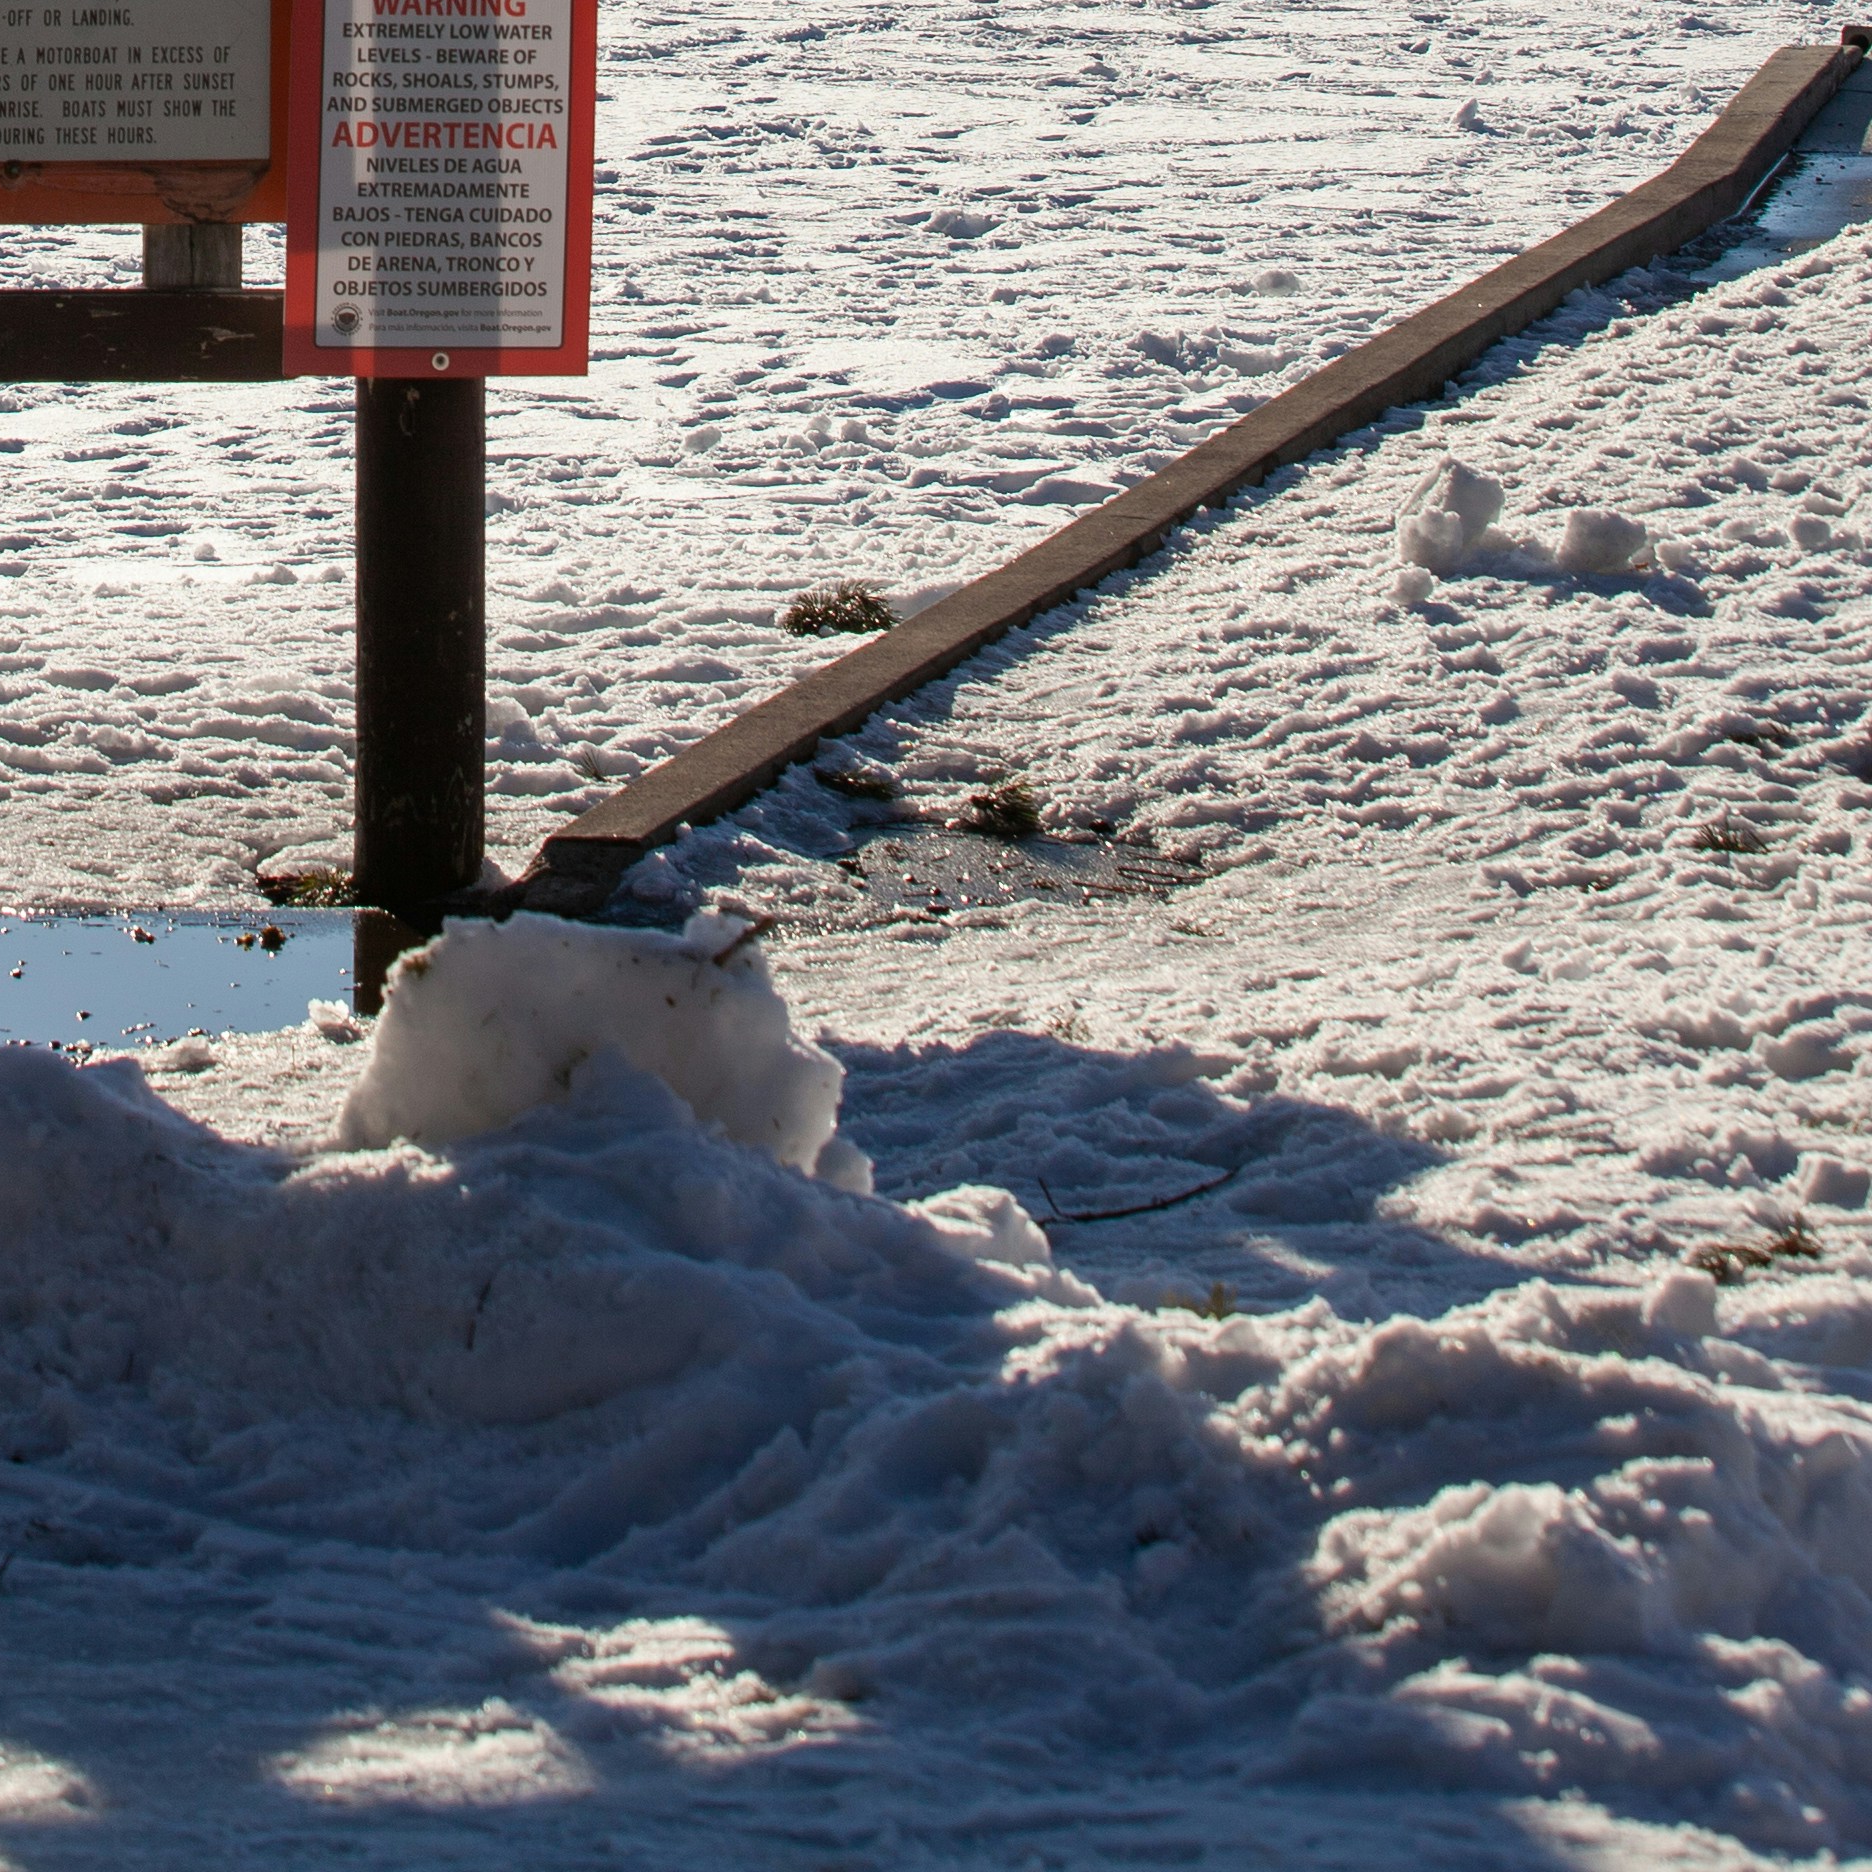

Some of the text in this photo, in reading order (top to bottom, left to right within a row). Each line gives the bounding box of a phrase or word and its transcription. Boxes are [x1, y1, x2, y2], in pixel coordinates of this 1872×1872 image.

[43, 9, 61, 26] OR
[72, 8, 133, 26] LANDING.
[342, 21, 552, 39] EXTREMELY LOW WATER
[357, 47, 420, 63] LEVELS
[436, 48, 508, 64] BEWARE
[513, 49, 536, 64] OF
[332, 71, 558, 90] ROCKS, SHOALS, STUMPS,
[327, 96, 563, 113] AND SUBMERGED OBJECTS
[331, 121, 557, 148] ADVERTENCIA
[366, 157, 522, 173] NIVELES DE AGUA
[356, 182, 529, 198] EXTREMADAMENTE
[333, 206, 389, 221] BAJOS
[404, 207, 464, 222] TENGA
[469, 207, 552, 222] CUIDADO
[340, 229, 542, 247] CON PIEDRAS, BANCOS
[347, 255, 534, 272] DE ARENA, TRONCO Y
[332, 280, 547, 296] OBJETOS SUMBERGIDOS
[368, 308, 386, 317] Visit
[387, 308, 459, 319] Boat.Oregon.gov
[461, 308, 472, 317] for
[496, 308, 543, 317] information
[369, 323, 552, 334] Para más información, visita Boat.Oregon.gov
